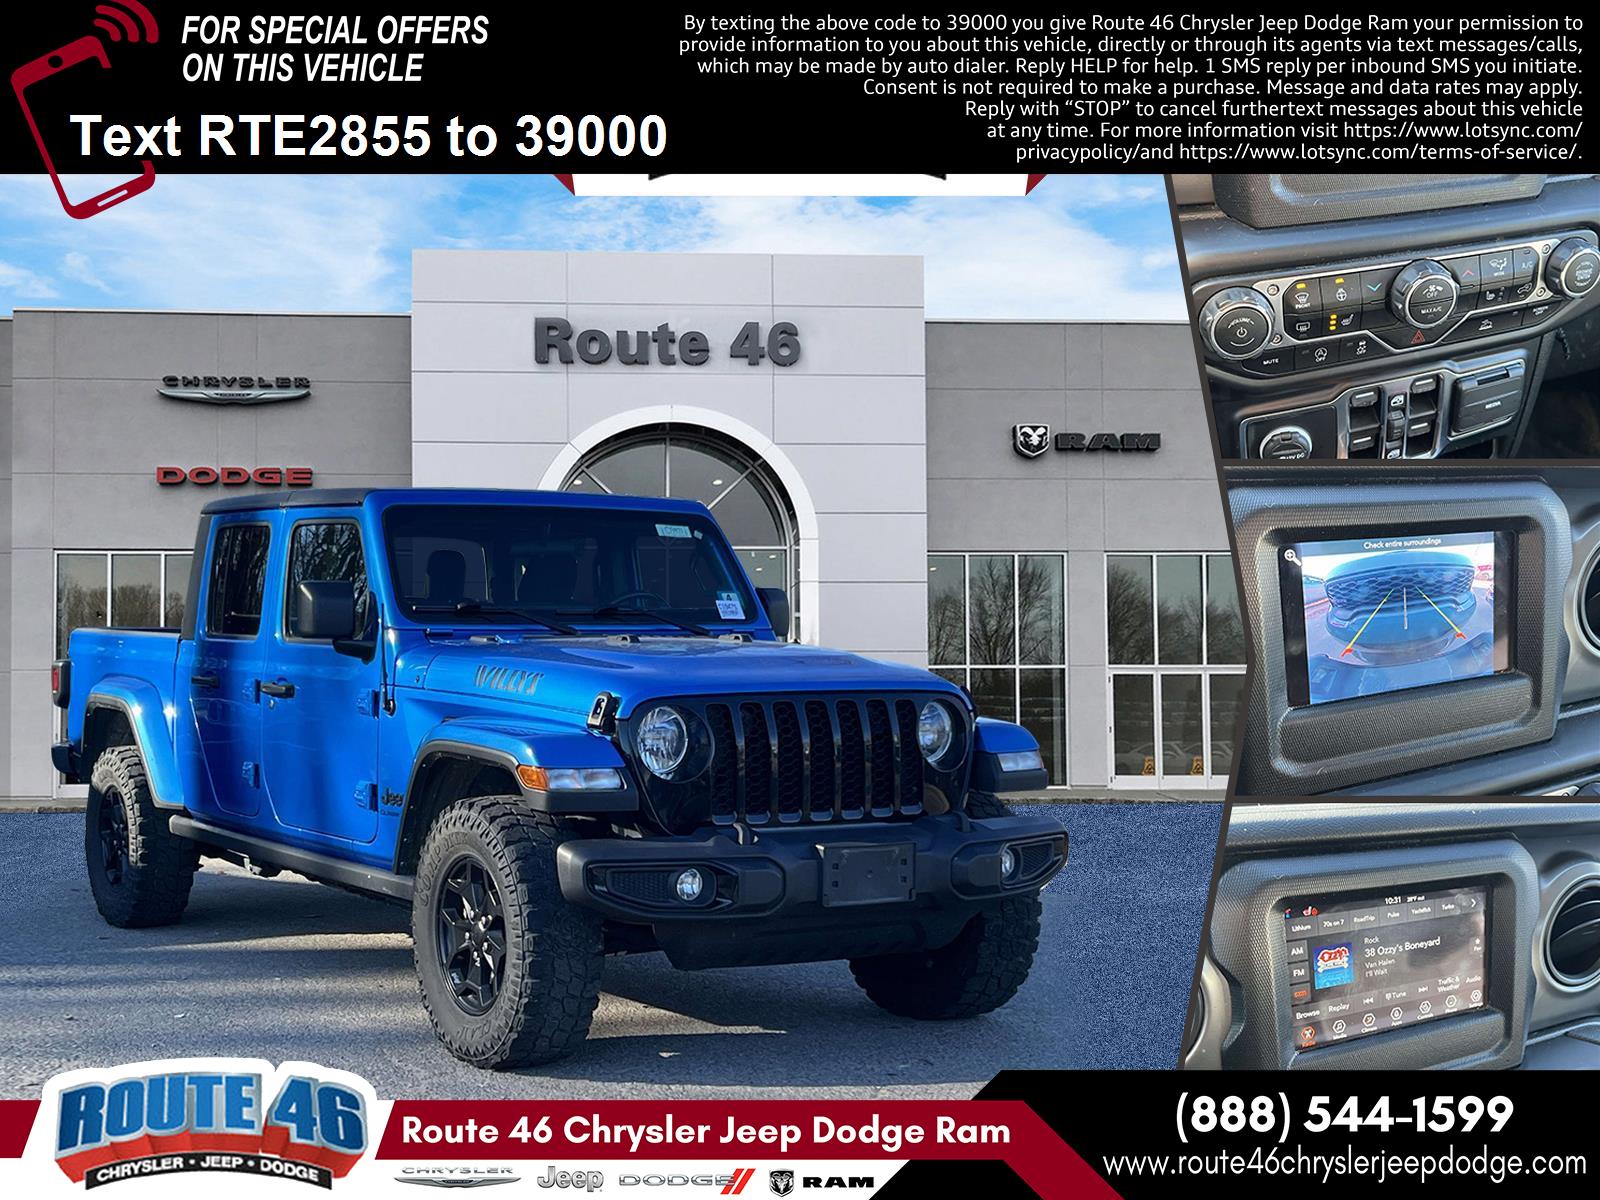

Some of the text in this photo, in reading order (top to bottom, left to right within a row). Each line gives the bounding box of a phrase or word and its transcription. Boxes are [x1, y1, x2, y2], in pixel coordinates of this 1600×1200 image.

[1521, 261, 1533, 269] A/C
[534, 317, 802, 366] Route 46
[162, 375, 311, 388] CHRYSLER
[1055, 433, 1161, 451] RAM
[156, 467, 313, 486] DODGE
[1363, 541, 1384, 549] Check
[1404, 537, 1442, 546] surroundings
[1385, 896, 1401, 904] 10:31
[1364, 936, 1380, 944] Rock
[1291, 946, 1304, 956] AM
[1365, 936, 1440, 957] 38 Ozzy's Boneyard
[1378, 958, 1395, 966] Halen
[1293, 968, 1305, 977] FM
[1328, 1003, 1349, 1012] Replay
[1296, 1009, 1320, 1019] Browse
